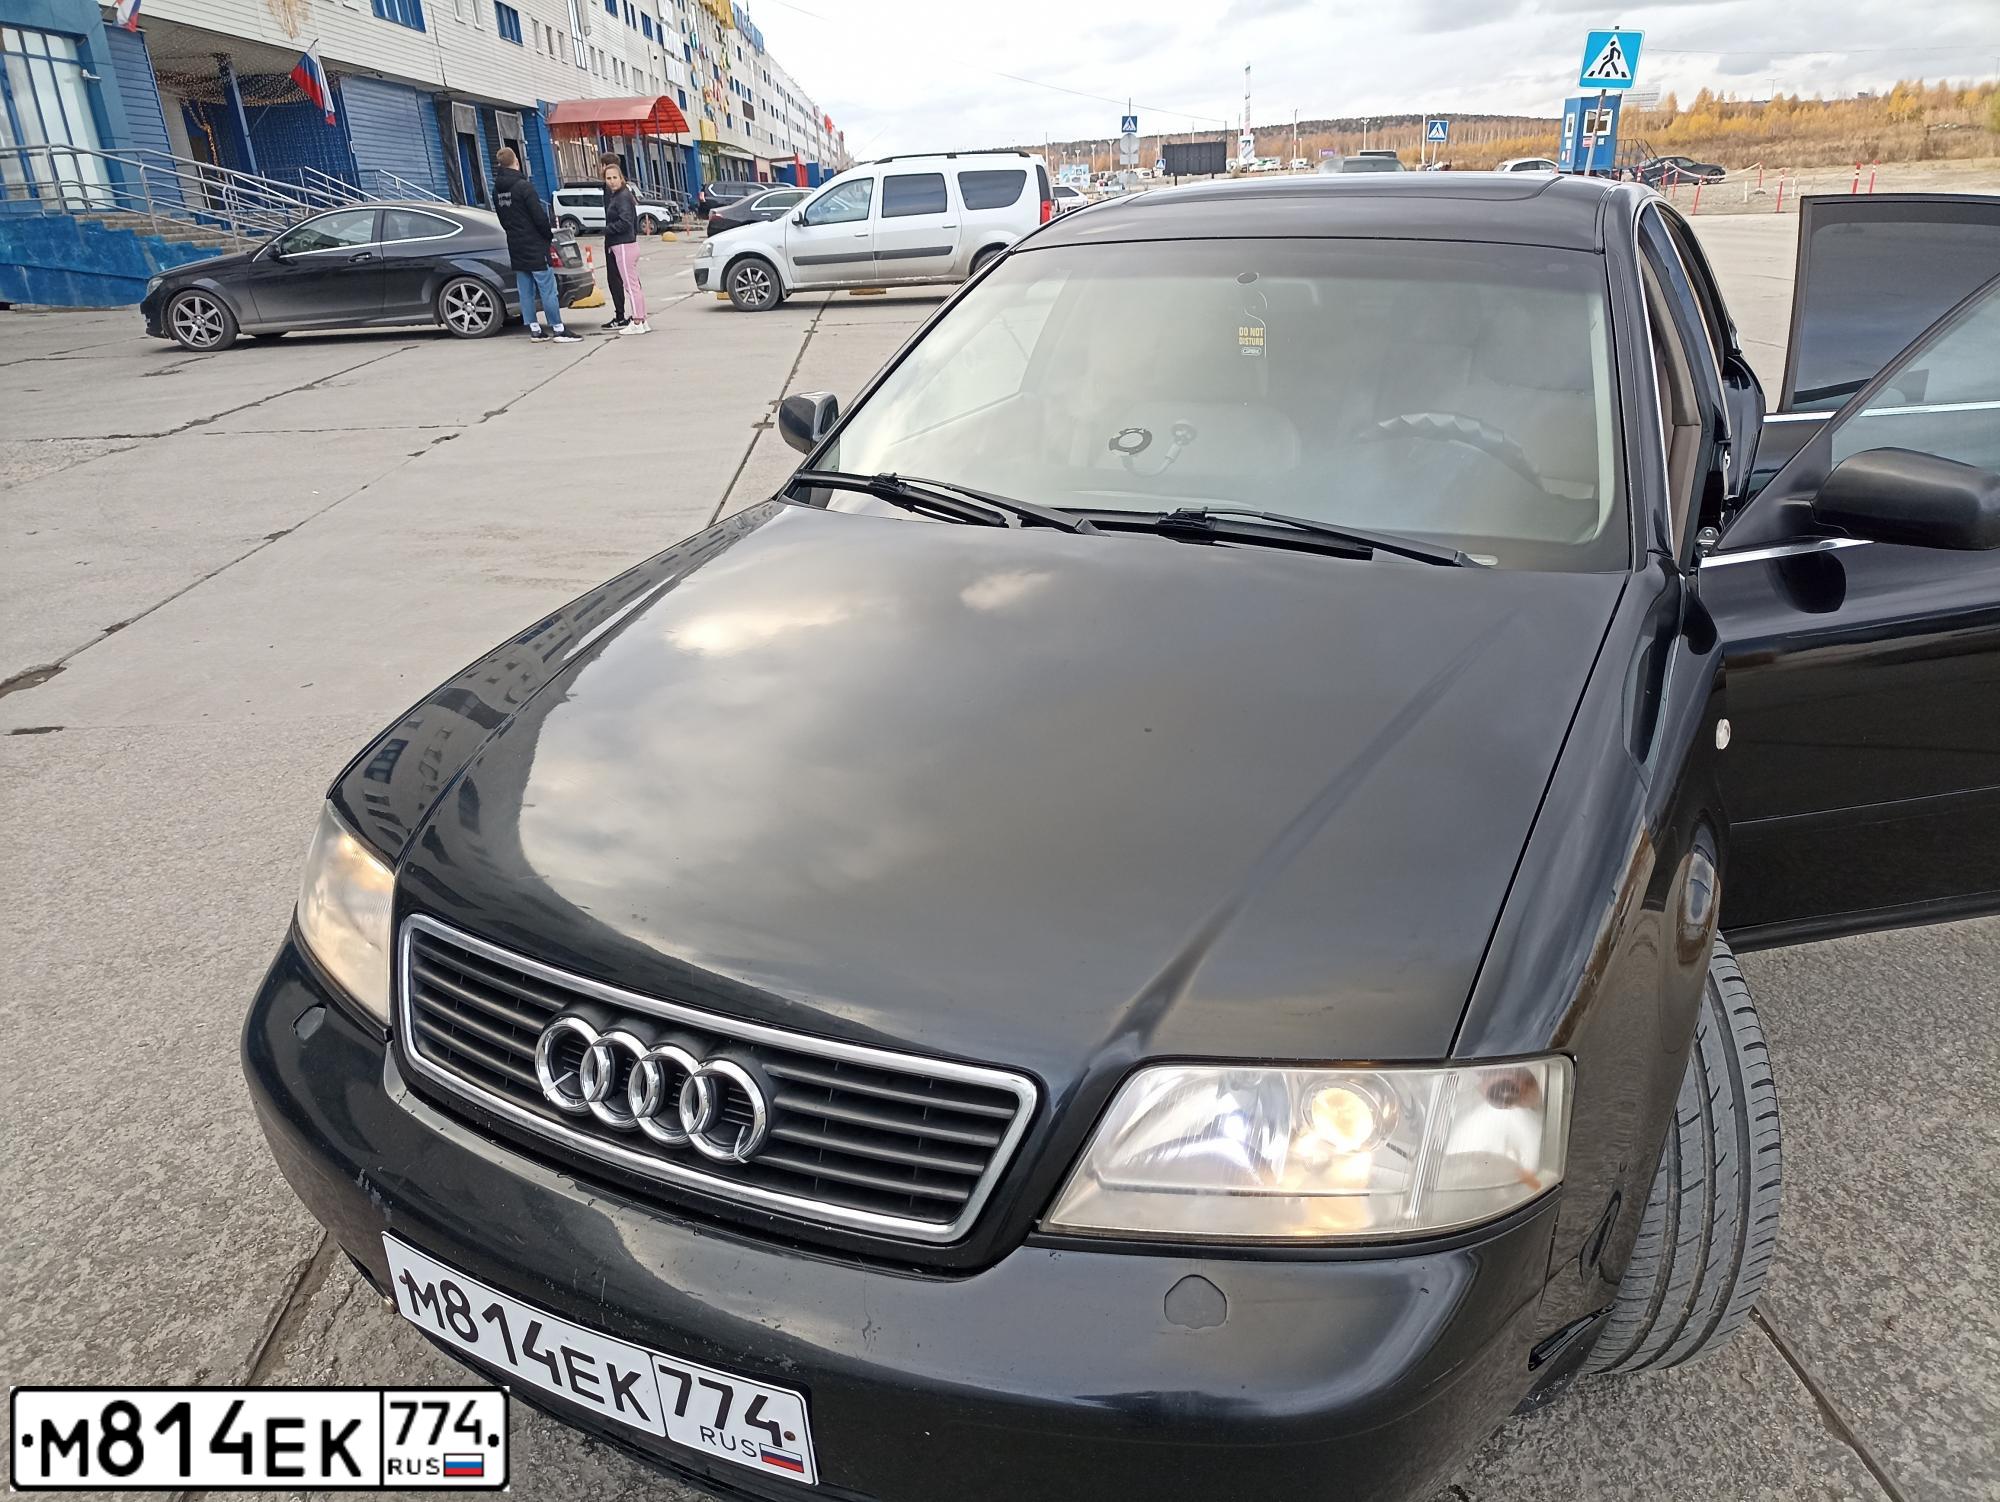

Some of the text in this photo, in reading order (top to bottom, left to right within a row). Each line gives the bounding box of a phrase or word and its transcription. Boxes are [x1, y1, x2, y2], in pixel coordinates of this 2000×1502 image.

[1238, 326, 1264, 337] DO NOT
[1238, 337, 1264, 346] DISTURB
[658, 1366, 784, 1448] 774
[699, 1425, 759, 1460] RUS
